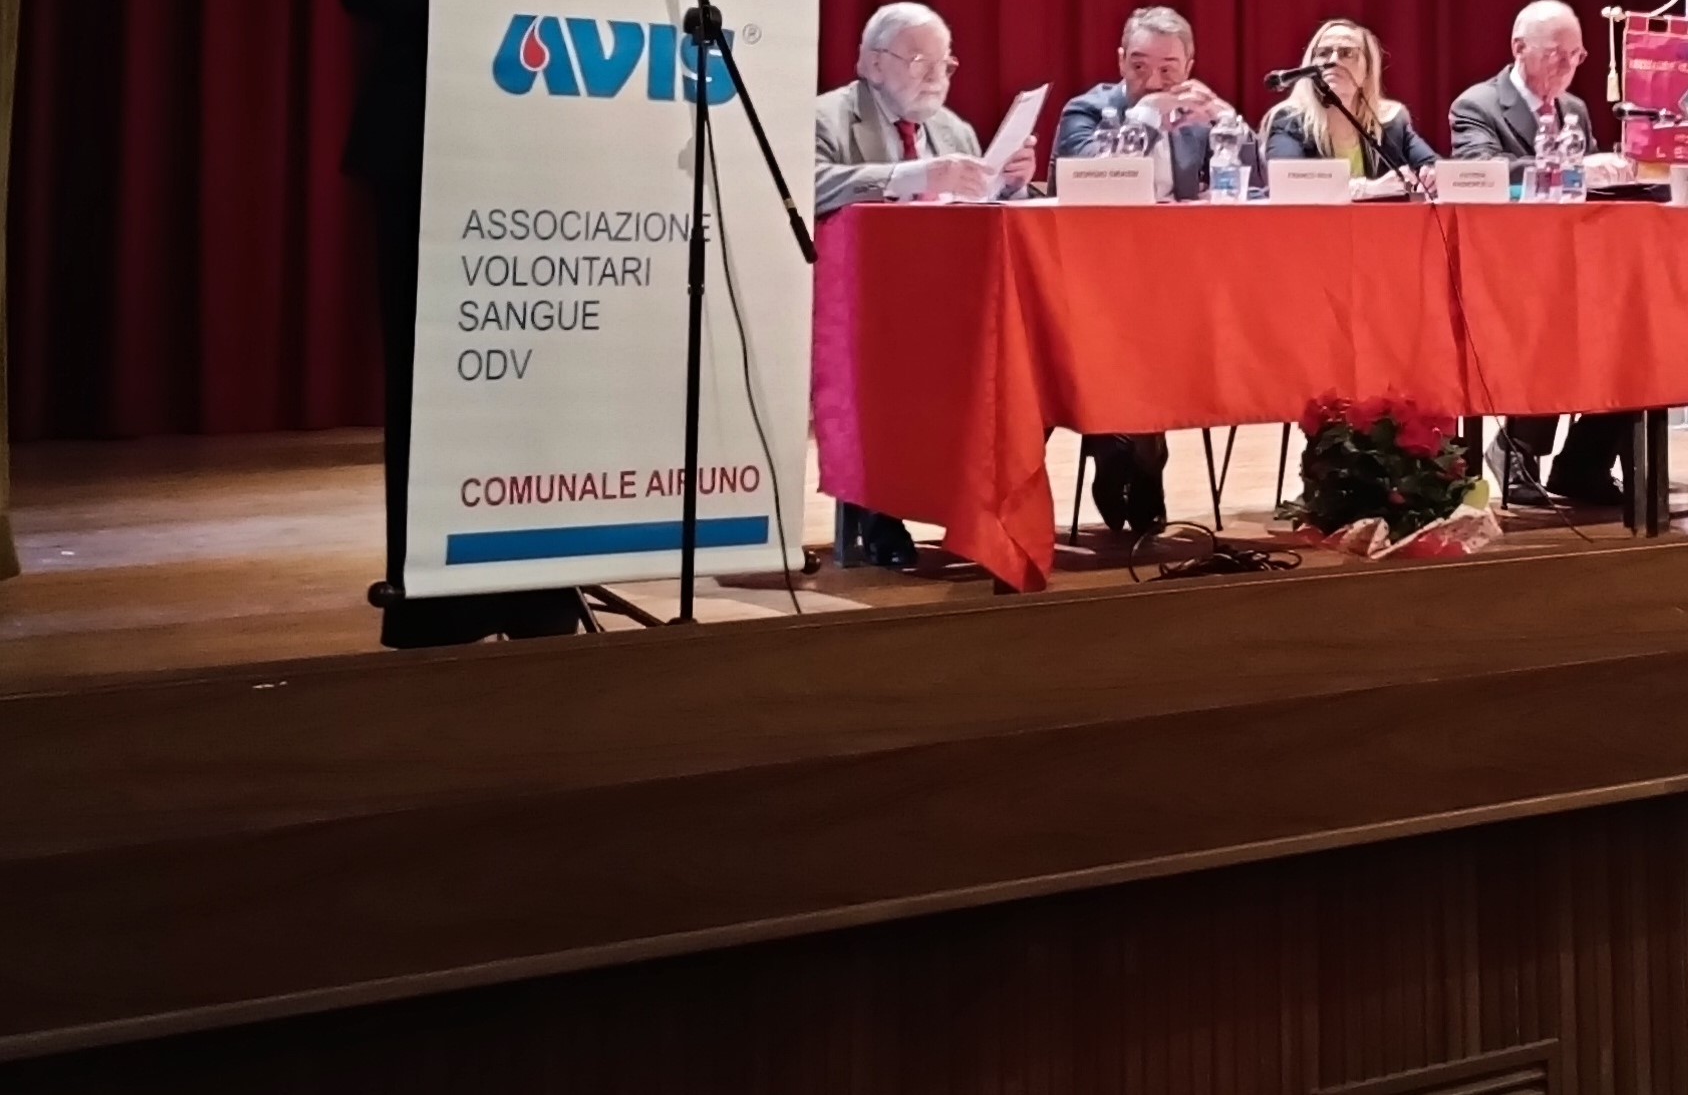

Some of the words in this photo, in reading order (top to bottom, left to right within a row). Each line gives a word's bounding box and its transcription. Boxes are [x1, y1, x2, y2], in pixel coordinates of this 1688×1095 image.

[462, 256, 651, 287] VOLONTARI
[458, 300, 600, 332] SANGUE
[457, 349, 533, 381] ODV
[461, 470, 637, 508] COMUNALE
